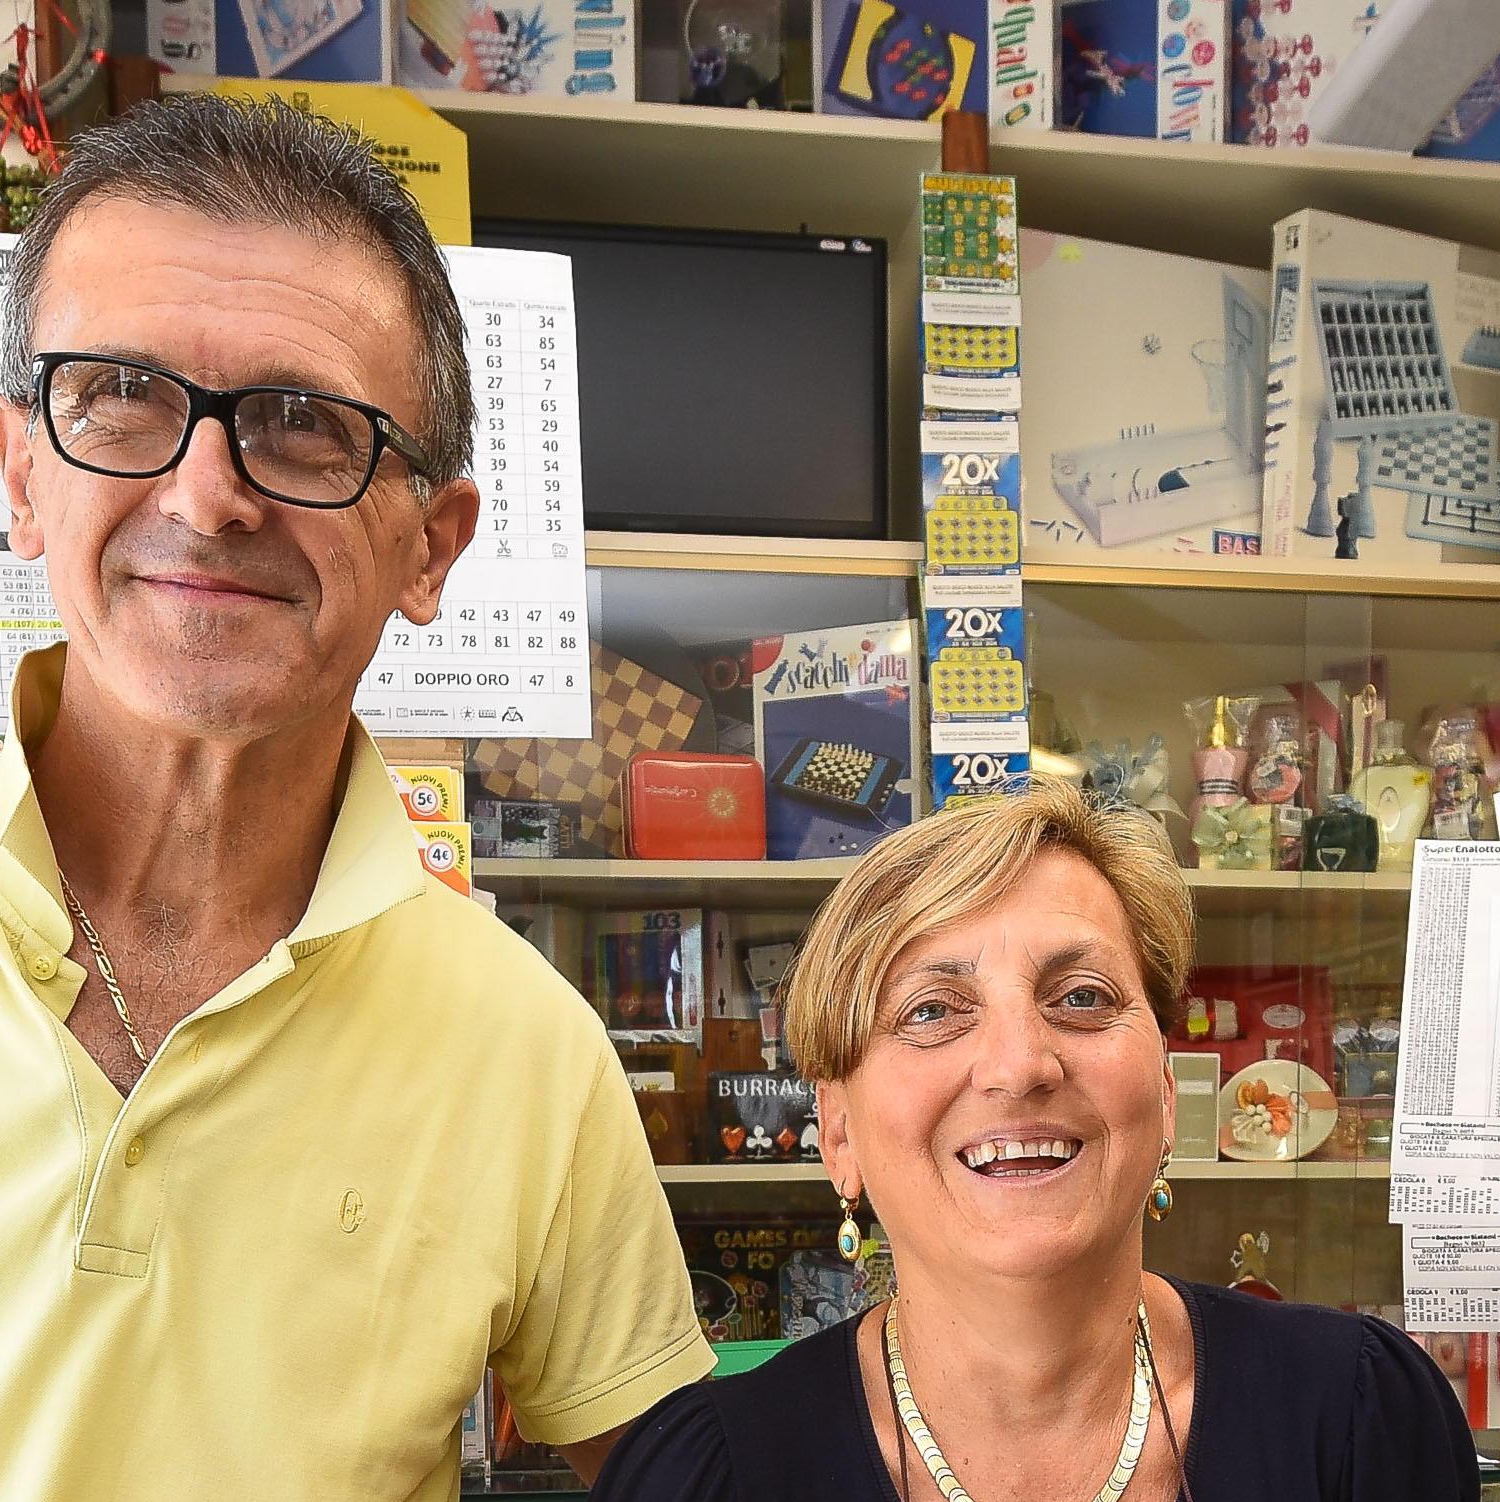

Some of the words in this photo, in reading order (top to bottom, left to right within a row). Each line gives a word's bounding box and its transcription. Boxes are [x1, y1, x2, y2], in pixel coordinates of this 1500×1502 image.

[484, 312, 502, 326] 30
[538, 315, 555, 329] 34
[485, 334, 502, 347] 63
[539, 336, 556, 350] 85
[486, 355, 503, 369] 63
[540, 357, 556, 371] 54
[487, 376, 503, 390] 27
[544, 379, 553, 392] 7
[488, 397, 505, 411] 39
[540, 399, 557, 412] 65
[488, 418, 505, 431] 53
[541, 419, 558, 432] 29
[489, 438, 506, 451] 36
[542, 440, 559, 453] 40
[490, 458, 507, 472] 39
[543, 459, 560, 473] 54
[495, 479, 503, 492] 8
[544, 479, 560, 492] 59
[492, 499, 508, 512] 70
[545, 499, 561, 512] 54
[493, 519, 509, 532] 17
[545, 519, 562, 532] 35
[459, 608, 476, 621] 42
[492, 609, 509, 621] 43
[526, 610, 542, 622] 47
[559, 610, 575, 623] 49
[393, 634, 410, 646] 72
[427, 634, 443, 647] 73
[460, 635, 477, 647] 78
[494, 636, 510, 648] 81
[527, 636, 543, 648] 82
[560, 637, 576, 649] 88
[377, 672, 394, 684] 47
[414, 672, 472, 686] DOPPIO
[476, 673, 510, 686] ORO
[528, 675, 545, 687] 47
[565, 675, 574, 688] 8
[410, 774, 437, 785] NUOVI
[427, 830, 455, 840] NUOVI
[714, 1228, 789, 1249] GAMES
